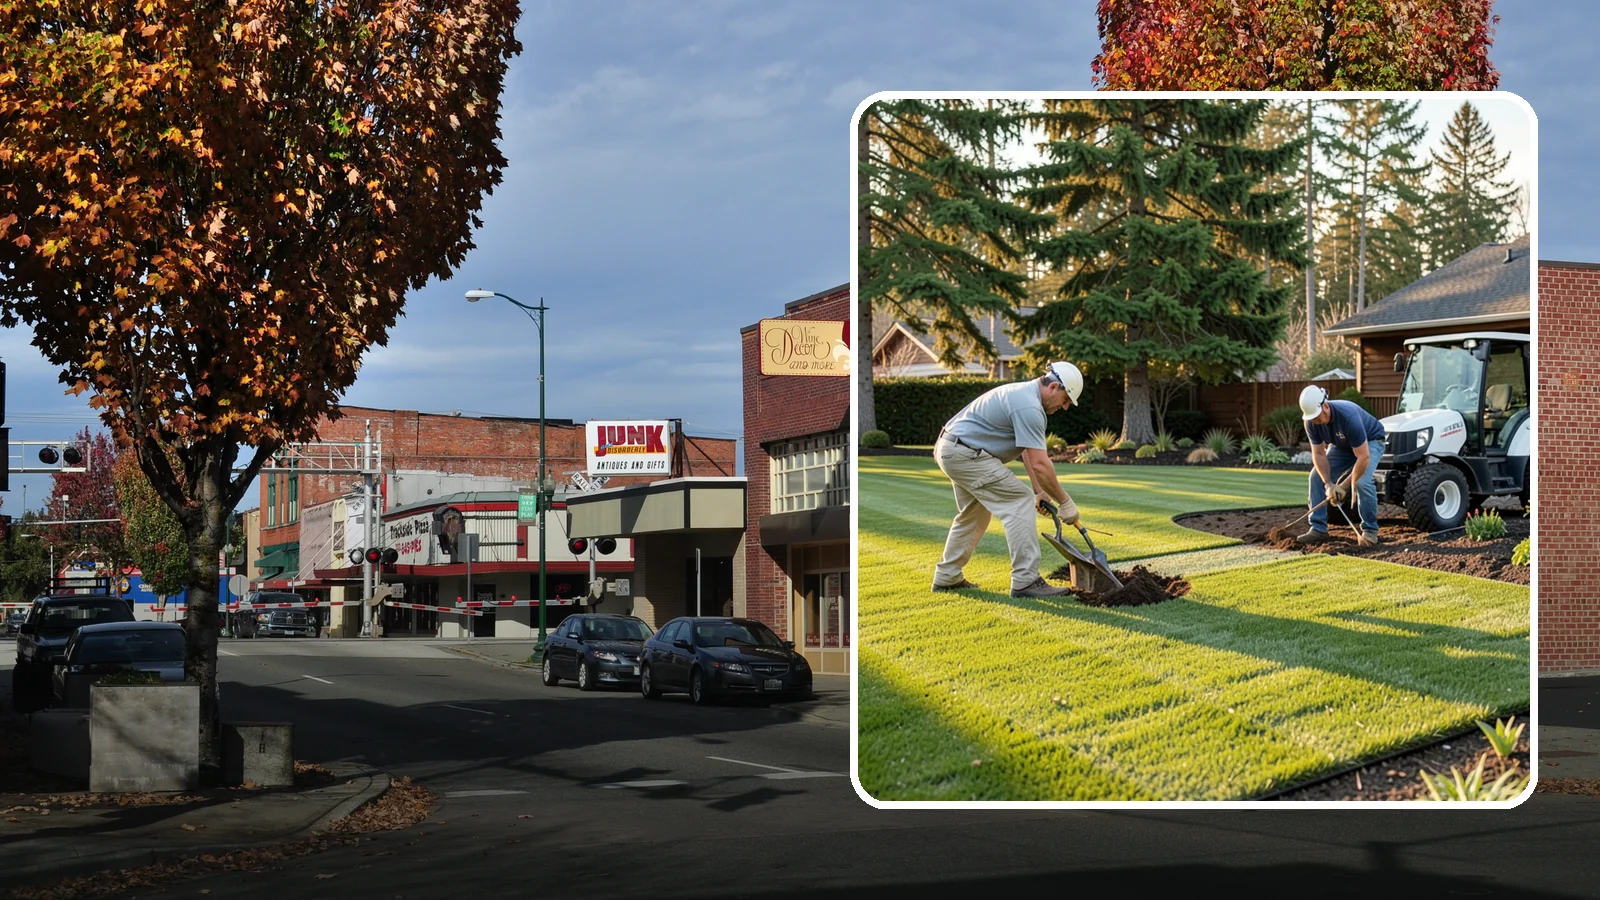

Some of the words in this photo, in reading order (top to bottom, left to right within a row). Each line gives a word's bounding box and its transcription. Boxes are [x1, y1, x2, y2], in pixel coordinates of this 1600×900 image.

[765, 328, 831, 365] Decor
[596, 425, 665, 457] JUNK
[597, 461, 628, 470] ANTIQUES
[631, 461, 644, 470] AND
[647, 460, 665, 469] GIFTS
[352, 498, 364, 511] CRO
[390, 521, 413, 539] Trackside
[414, 519, 429, 534] Pizza
